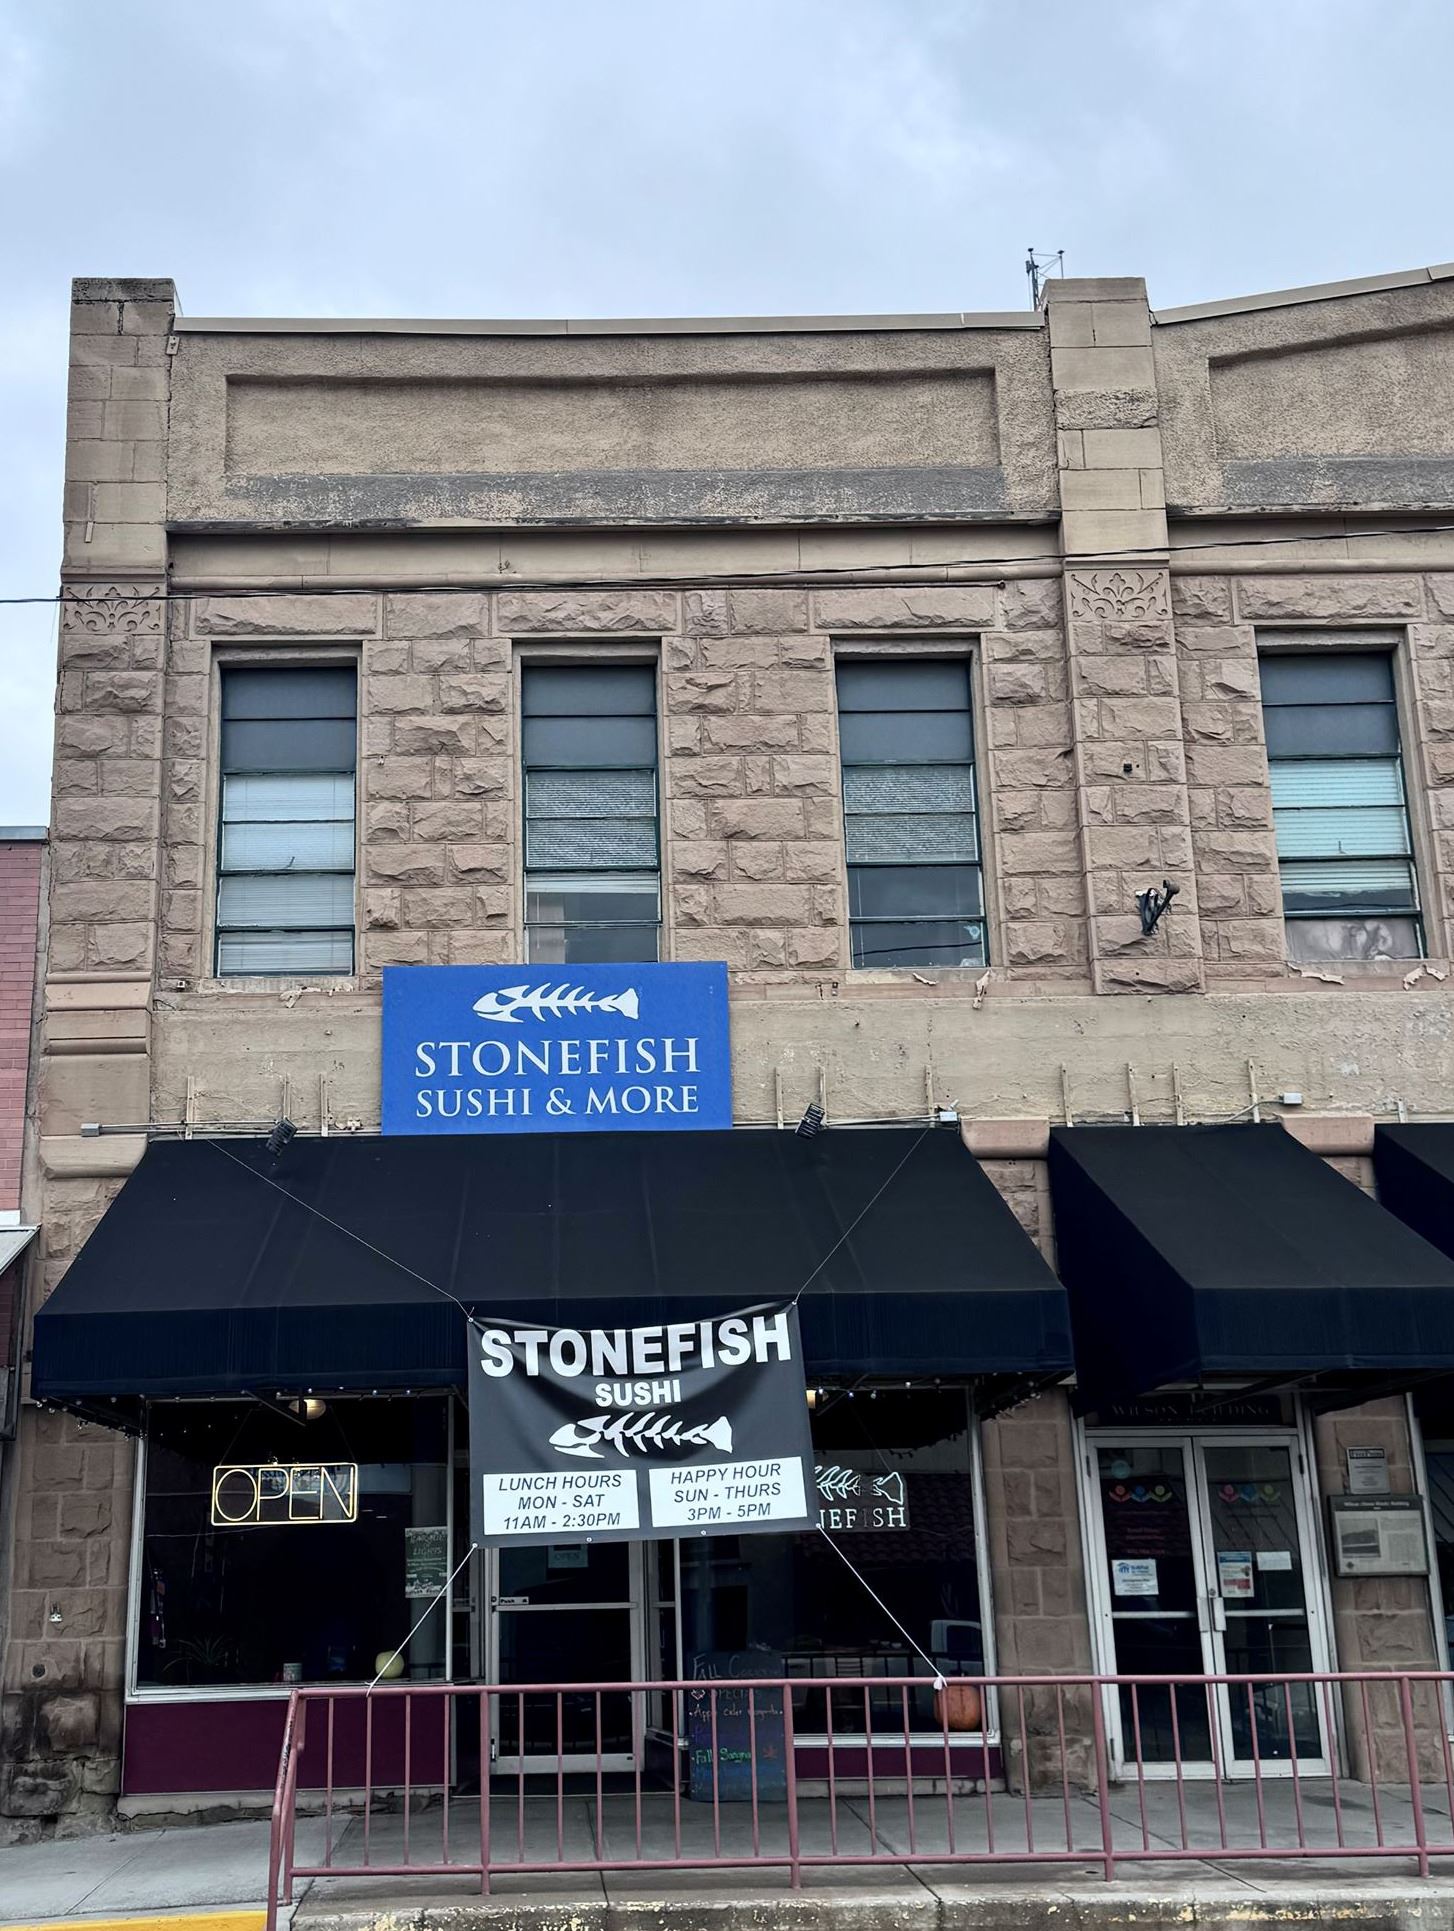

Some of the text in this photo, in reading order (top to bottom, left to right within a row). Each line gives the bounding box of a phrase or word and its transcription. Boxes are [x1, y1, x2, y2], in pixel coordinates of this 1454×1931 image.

[415, 1037, 701, 1078] STONEFISH
[416, 1085, 700, 1118] SUSHI & MORE
[480, 1312, 792, 1378] STONEFISH
[595, 1379, 682, 1407] SUSHI
[498, 1474, 622, 1492] LUNCH HOURS
[671, 1463, 781, 1485] HAPPY HOUR
[215, 1466, 354, 1522] OPEN
[518, 1495, 557, 1510] MON
[572, 1493, 606, 1508] SAT
[674, 1488, 711, 1503] SUN
[725, 1482, 781, 1499] THURS
[503, 1514, 547, 1530] 11AM
[562, 1512, 621, 1528] 2:30PM
[687, 1506, 722, 1521] 3PM
[737, 1503, 771, 1518] 5PM
